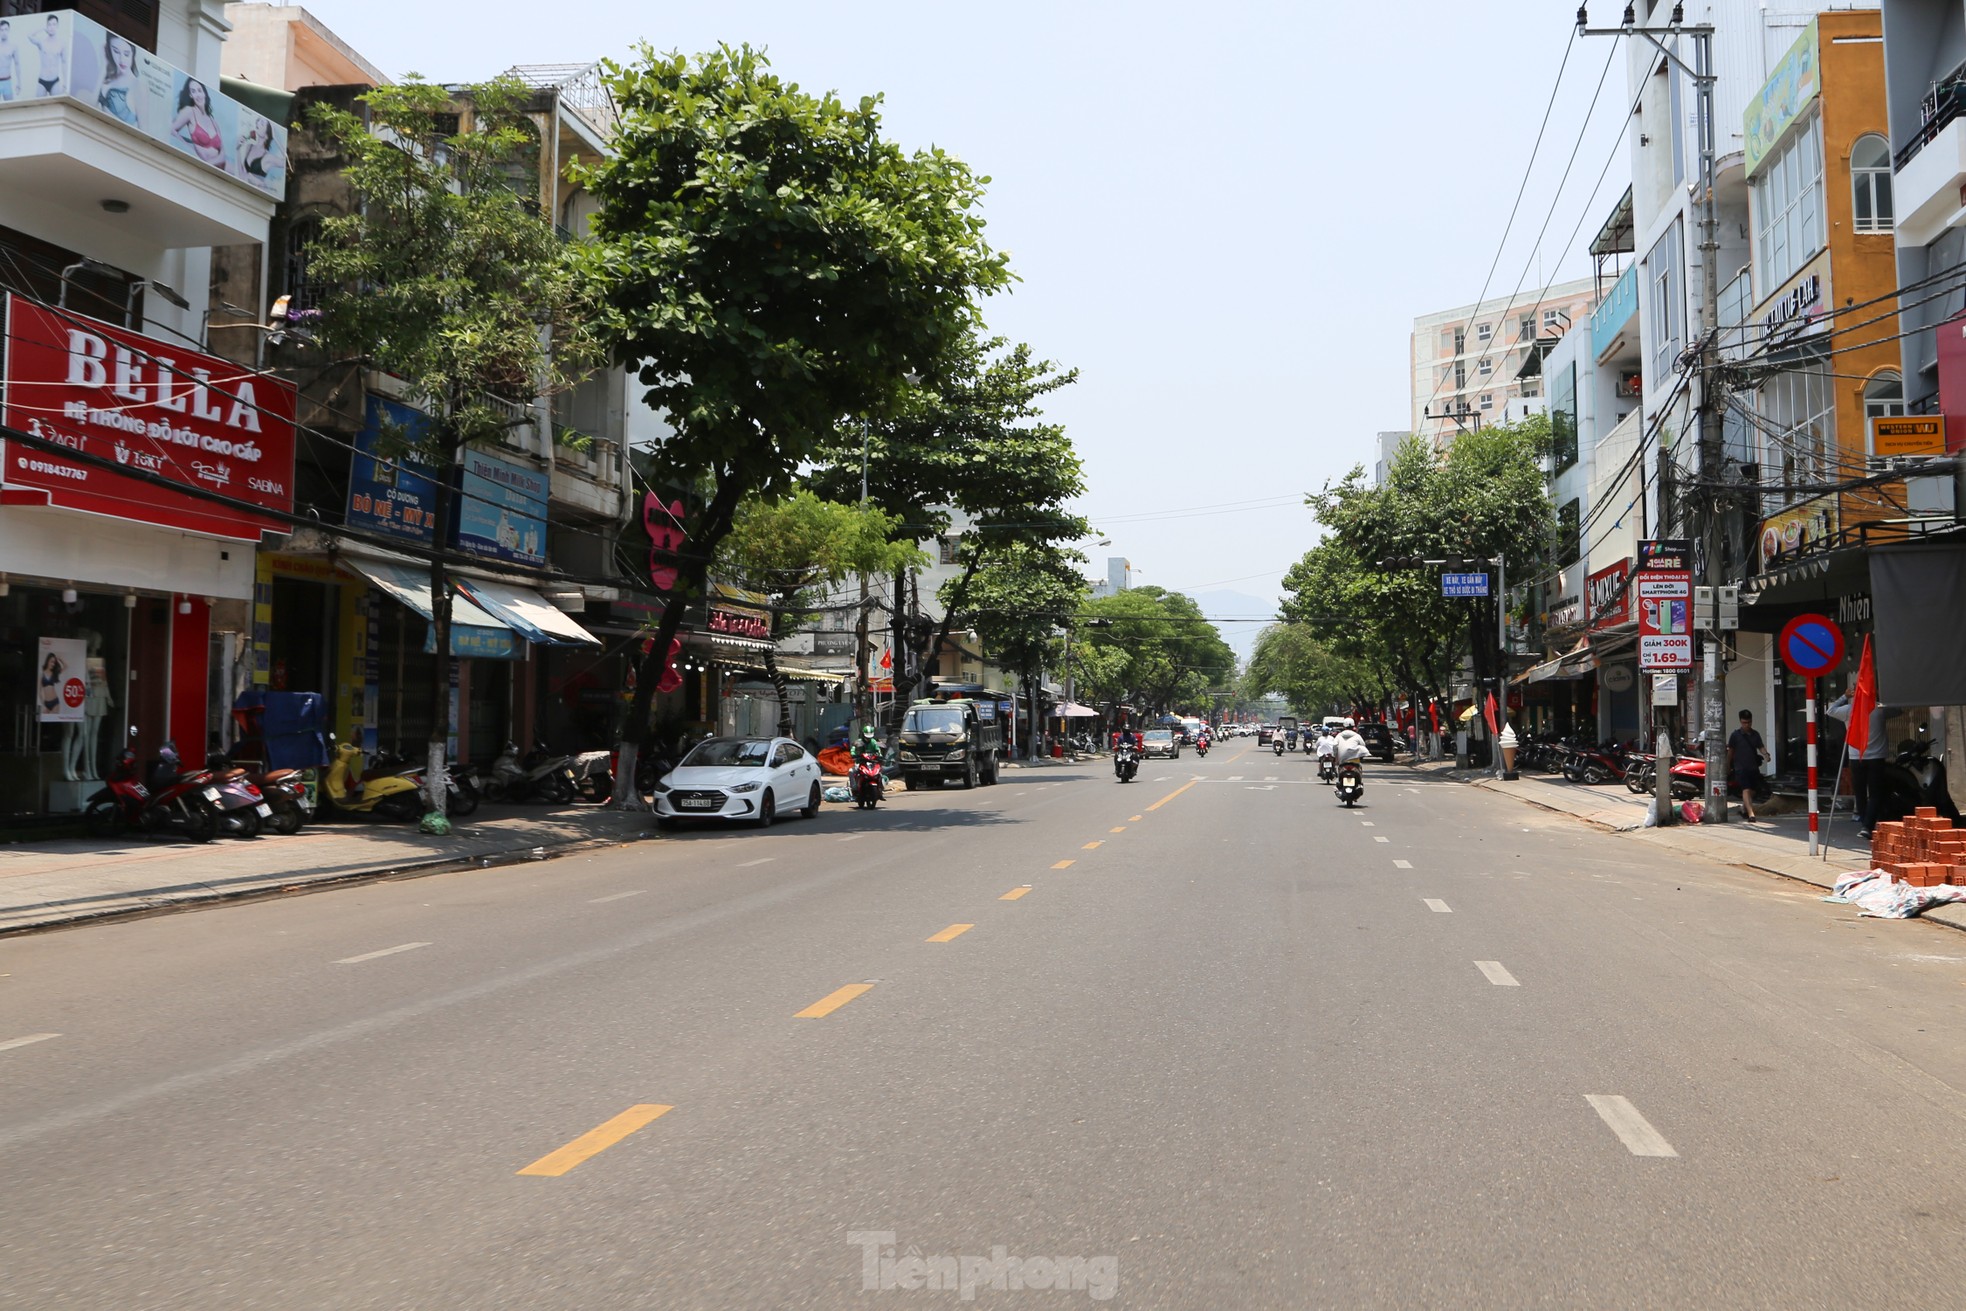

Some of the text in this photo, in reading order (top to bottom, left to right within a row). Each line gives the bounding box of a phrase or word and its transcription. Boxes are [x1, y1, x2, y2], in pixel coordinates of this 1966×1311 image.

[65, 328, 262, 433] BELLA
[201, 436, 232, 455] CAO
[233, 441, 262, 462] CẤP
[474, 460, 492, 479] Thiện
[493, 466, 510, 484] Minh
[526, 476, 541, 494] Shop
[1642, 544, 1662, 554] FPT
[1663, 639, 1688, 647] 300K
[1652, 653, 1677, 663] 1.69
